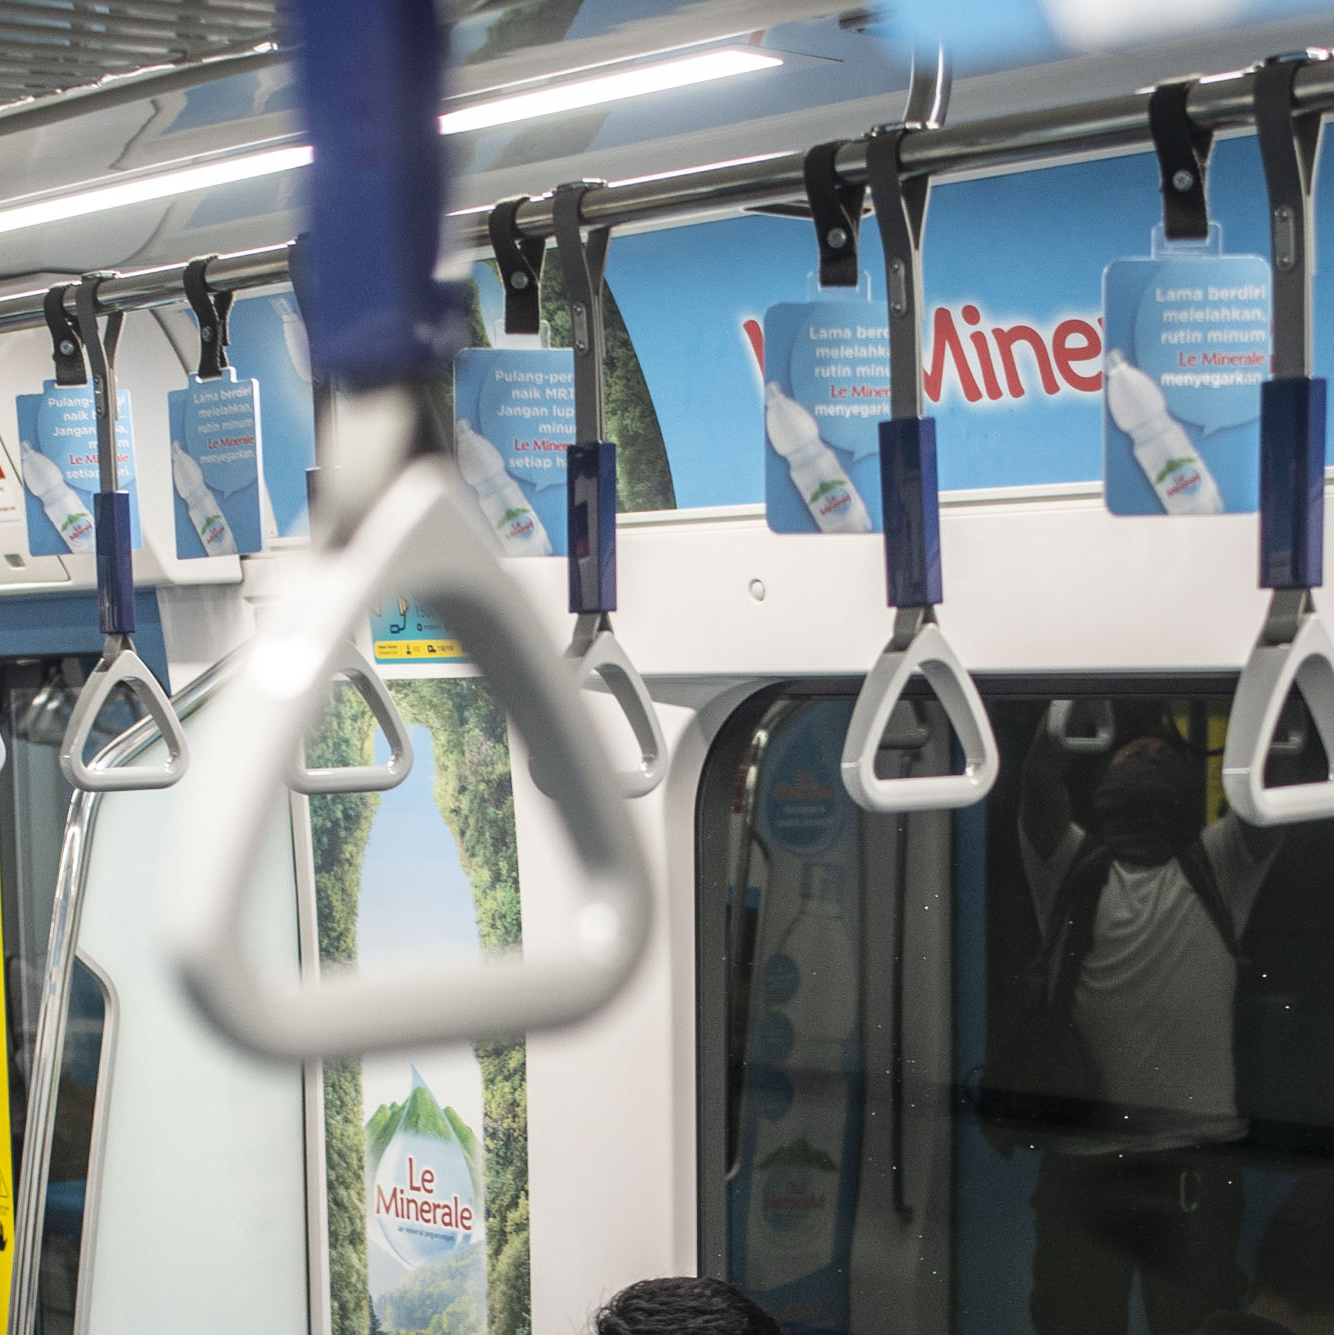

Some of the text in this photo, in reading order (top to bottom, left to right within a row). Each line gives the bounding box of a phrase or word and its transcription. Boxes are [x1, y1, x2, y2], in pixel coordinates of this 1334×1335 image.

[1155, 285, 1267, 302] Lama berdiri
[1162, 307, 1267, 324] melelahkan,
[809, 326, 852, 341] Lama
[1160, 328, 1267, 345] rutin minum
[1178, 351, 1265, 368] Le Minerale
[495, 370, 574, 385] Pulang-per
[814, 364, 852, 378] rutin
[194, 391, 218, 404] Lama
[511, 388, 541, 400] naik
[830, 384, 891, 399] Le Miner
[63, 410, 89, 421] naik
[497, 405, 548, 419] Jangan
[815, 403, 891, 419] menyegark
[52, 426, 95, 438] Jangan
[208, 438, 218, 450] Le
[514, 438, 530, 451] Le
[70, 454, 81, 465] Le
[508, 455, 553, 470] setiap
[408, 1157, 435, 1194] Le
[375, 1184, 473, 1231] Minerale
